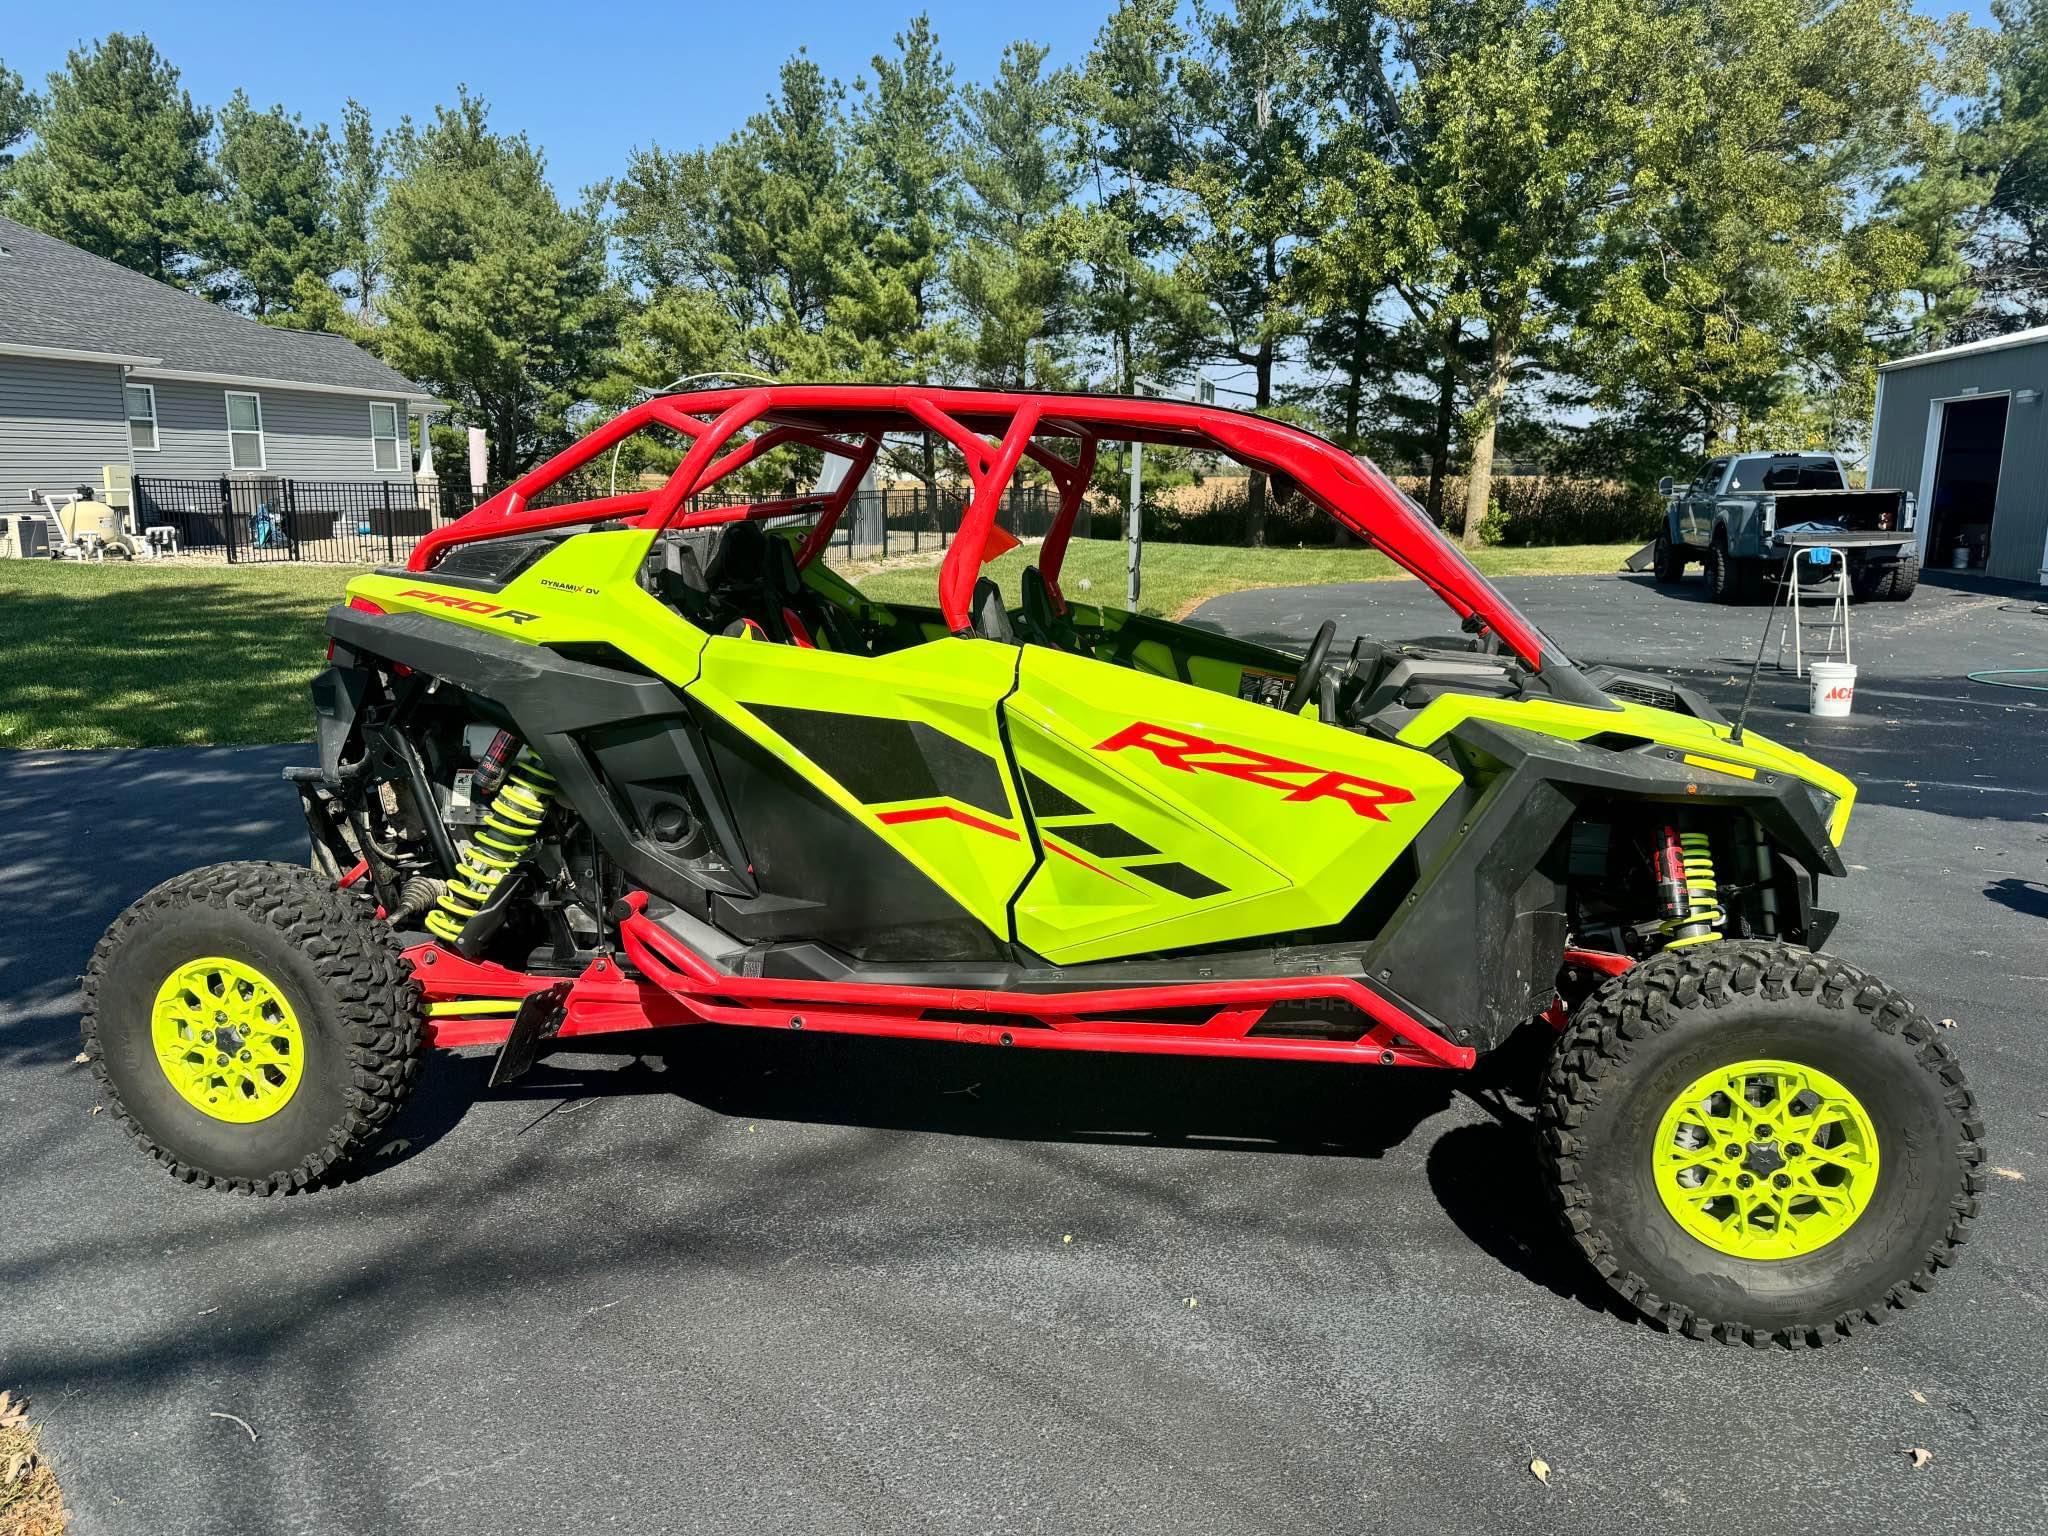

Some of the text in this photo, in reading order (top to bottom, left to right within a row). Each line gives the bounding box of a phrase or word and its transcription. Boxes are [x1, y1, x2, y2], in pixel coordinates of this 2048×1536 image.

[540, 578, 600, 596] DYNAMIX DV
[395, 589, 542, 625] PRO R
[1090, 721, 1417, 823] RZR
